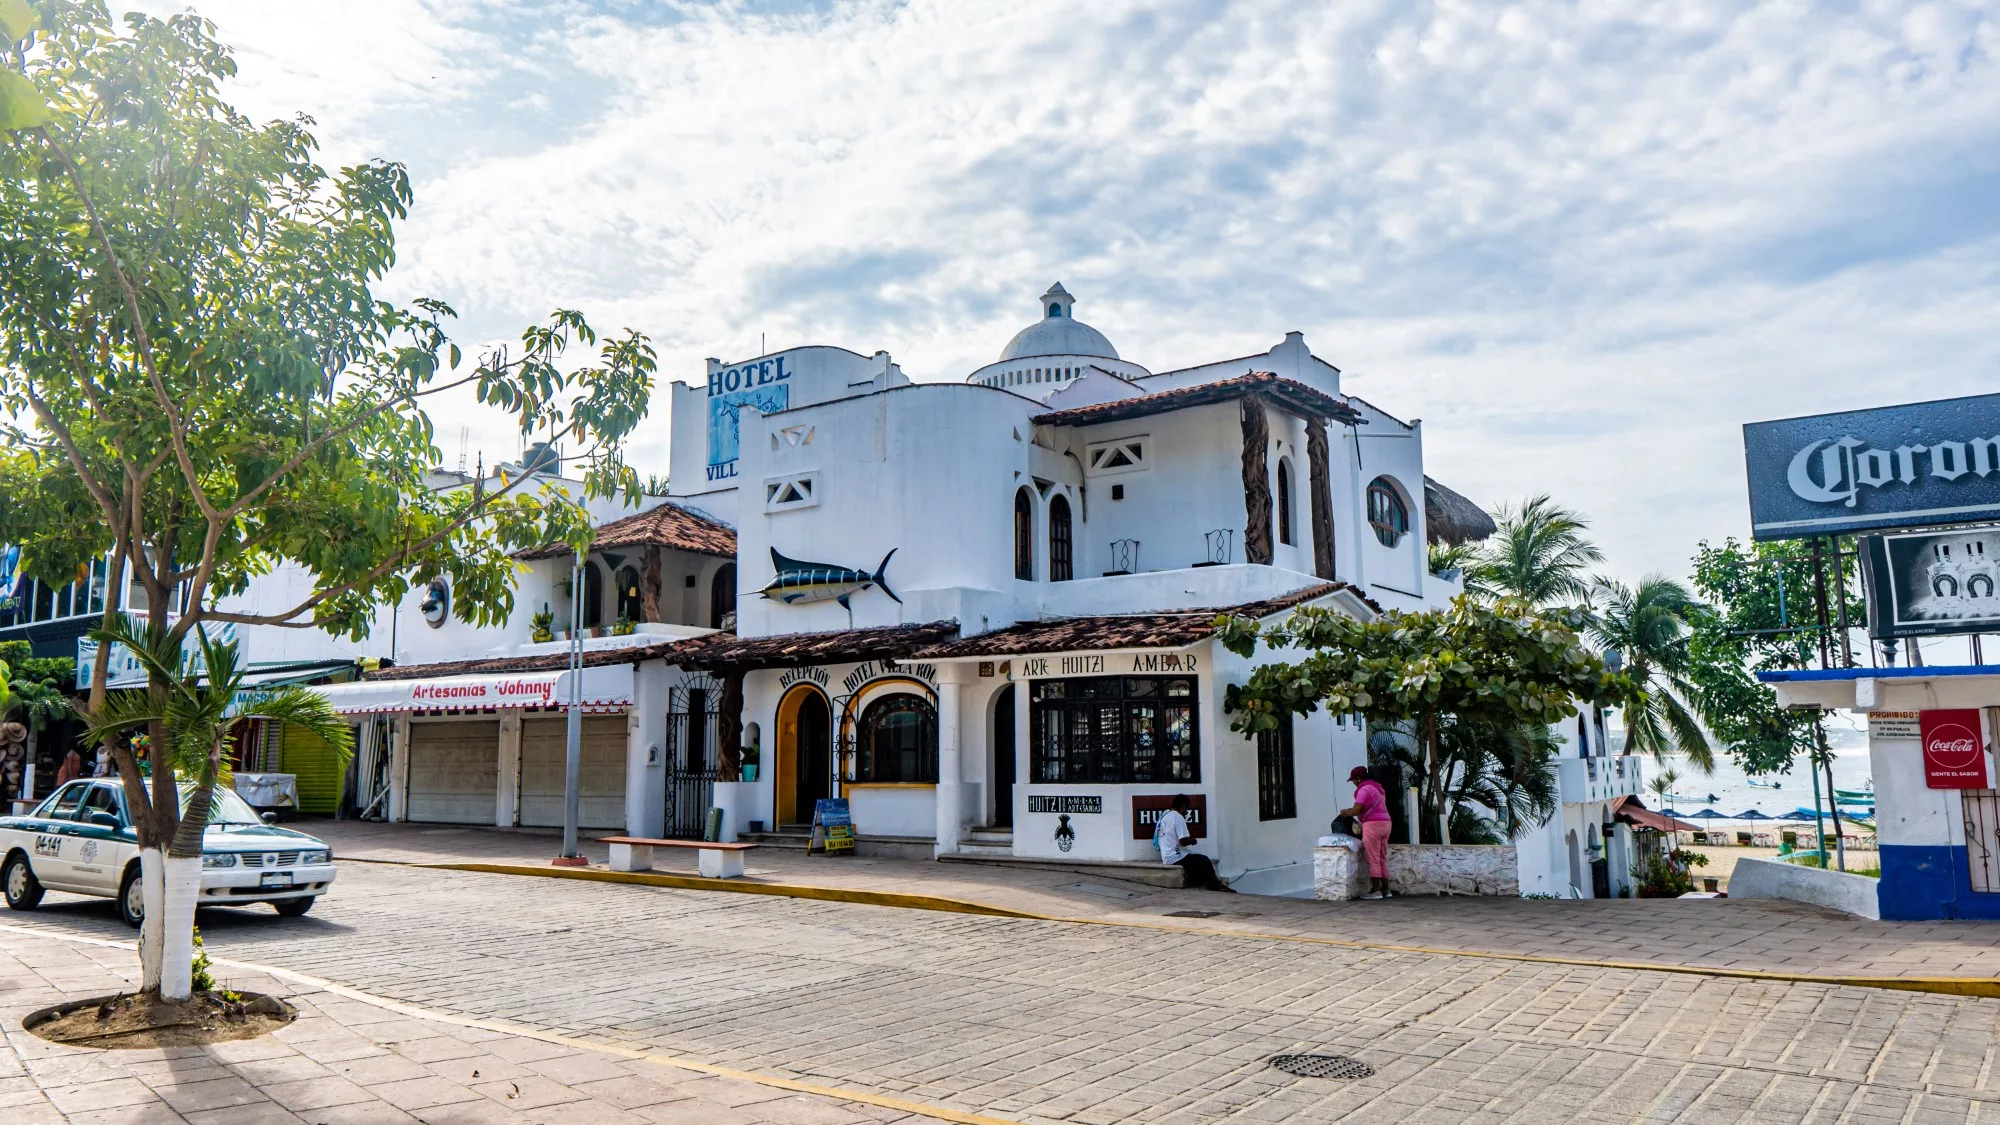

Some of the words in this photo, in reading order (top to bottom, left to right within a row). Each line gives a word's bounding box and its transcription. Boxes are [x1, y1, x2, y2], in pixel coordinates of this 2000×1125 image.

[707, 356, 791, 397] HOTEL
[1023, 658, 1048, 676] ARTE
[1061, 655, 1104, 674] HUITZI
[779, 665, 831, 689] RECEPCIÓN
[843, 660, 876, 693] HOTEL
[412, 683, 486, 699] Artesanías
[1029, 796, 1062, 812] HUITZI
[1140, 809, 1199, 824] HUZI
[35, 835, 62, 852] 04-141
